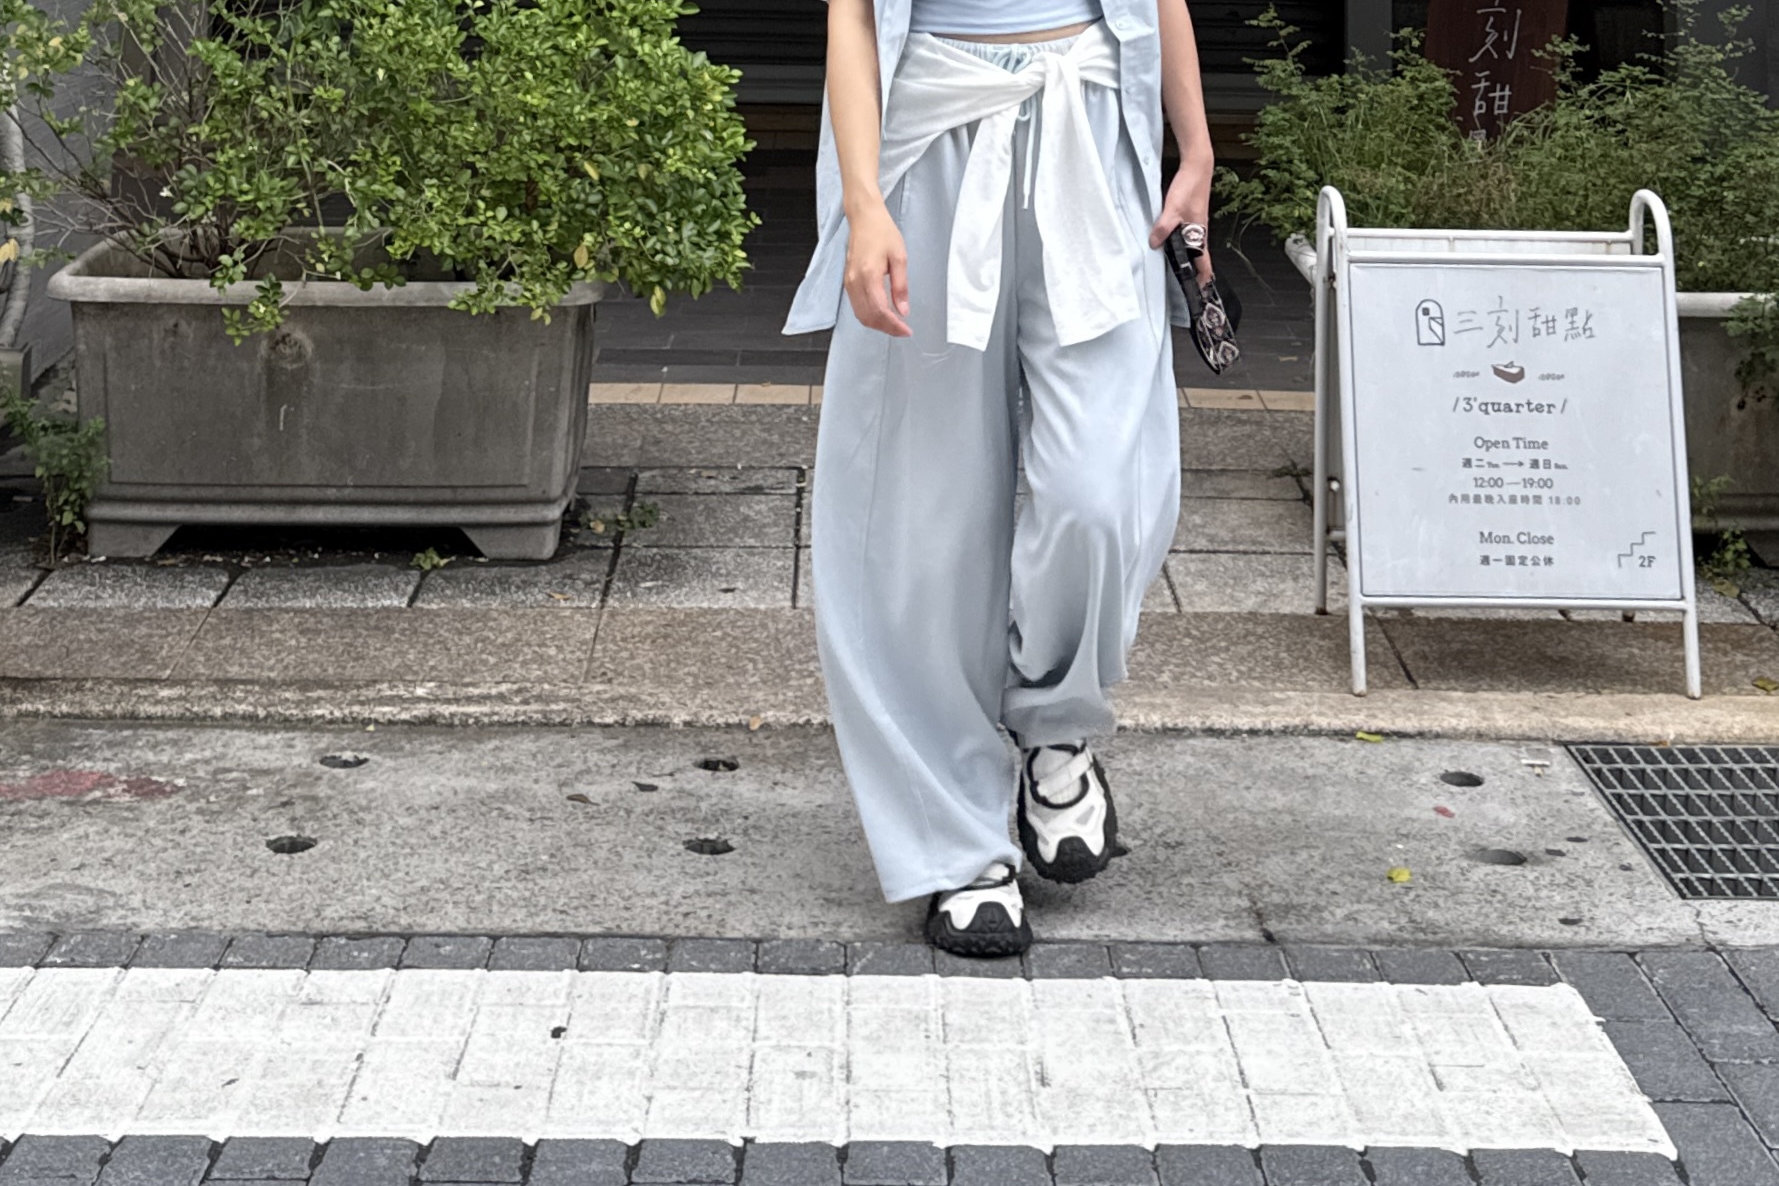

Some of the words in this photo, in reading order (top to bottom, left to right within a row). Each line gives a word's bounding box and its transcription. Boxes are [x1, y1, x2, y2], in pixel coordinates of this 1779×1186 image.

[1454, 296, 1595, 348] 三刻甜點
[1474, 436, 1510, 452] Open
[1512, 437, 1548, 450] Time
[1462, 457, 1485, 469] 週二
[1529, 458, 1552, 470] 週日
[1517, 532, 1554, 545] Close
[1479, 554, 1554, 567] 週一固定公休
[1639, 555, 1656, 567] 2F
